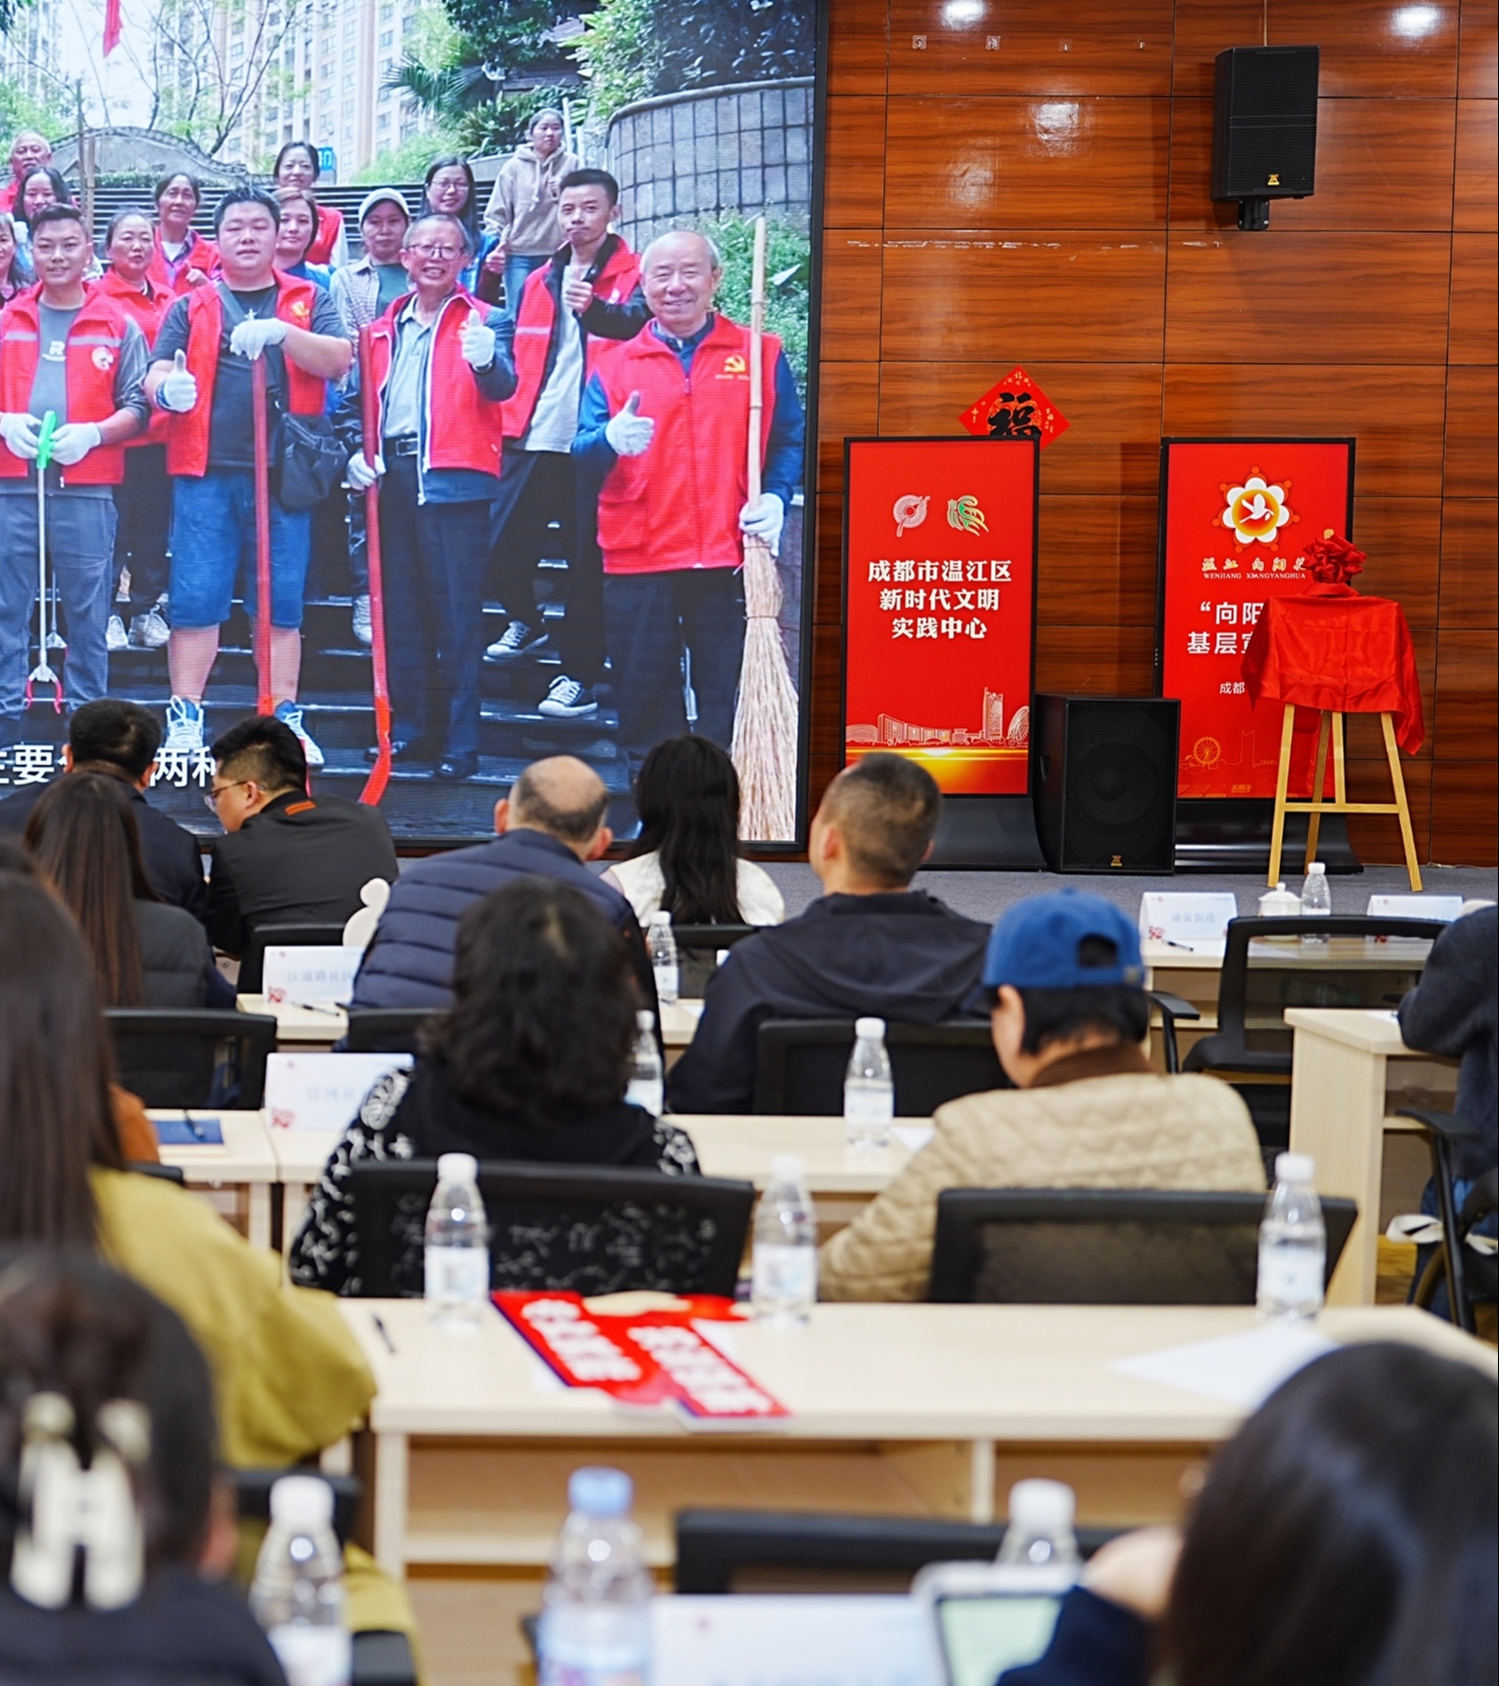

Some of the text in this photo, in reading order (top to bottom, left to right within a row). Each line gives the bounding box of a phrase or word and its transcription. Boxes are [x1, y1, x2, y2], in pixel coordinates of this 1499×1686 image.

[987, 392, 1042, 436] 福
[868, 560, 1012, 582] 成都市温江区
[879, 588, 1000, 611] 新时代文明
[892, 617, 987, 639] 实践中心
